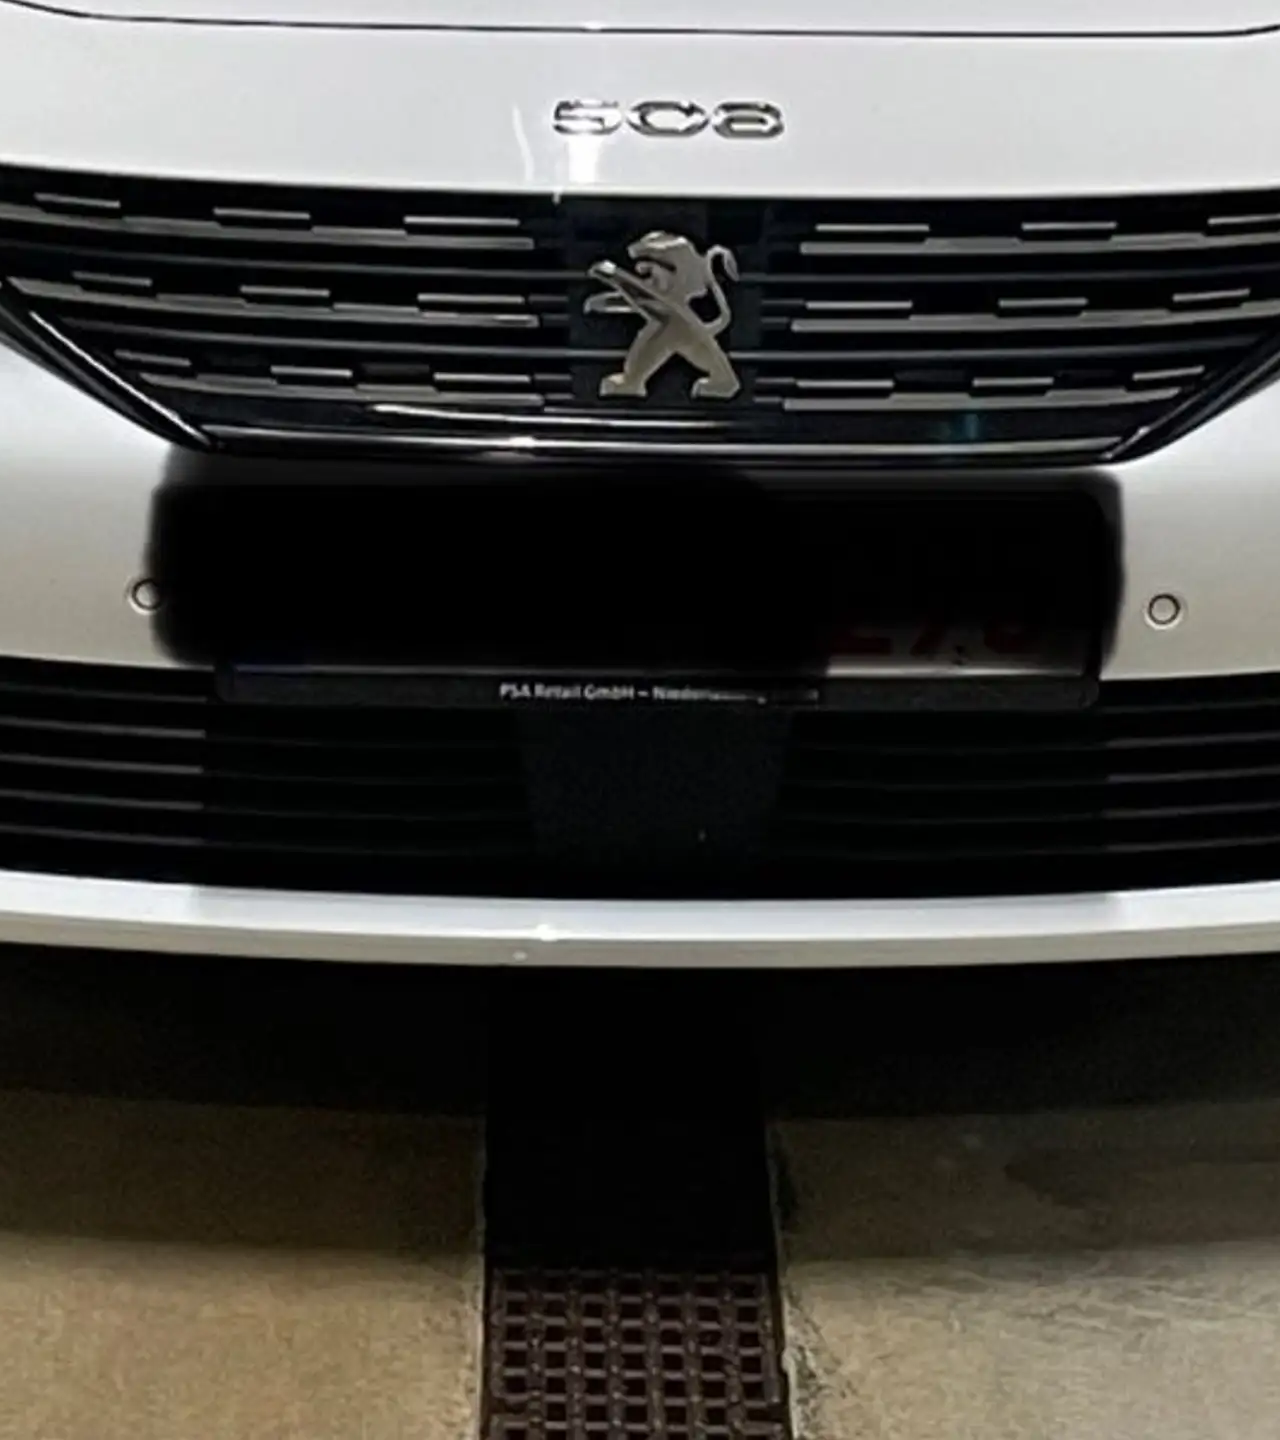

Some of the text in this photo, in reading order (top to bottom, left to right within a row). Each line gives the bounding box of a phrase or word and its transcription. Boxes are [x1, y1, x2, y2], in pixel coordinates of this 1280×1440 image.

[553, 99, 786, 140] 508
[499, 682, 531, 700] PSA
[534, 682, 581, 700] Retail
[583, 683, 634, 701] GmbH
